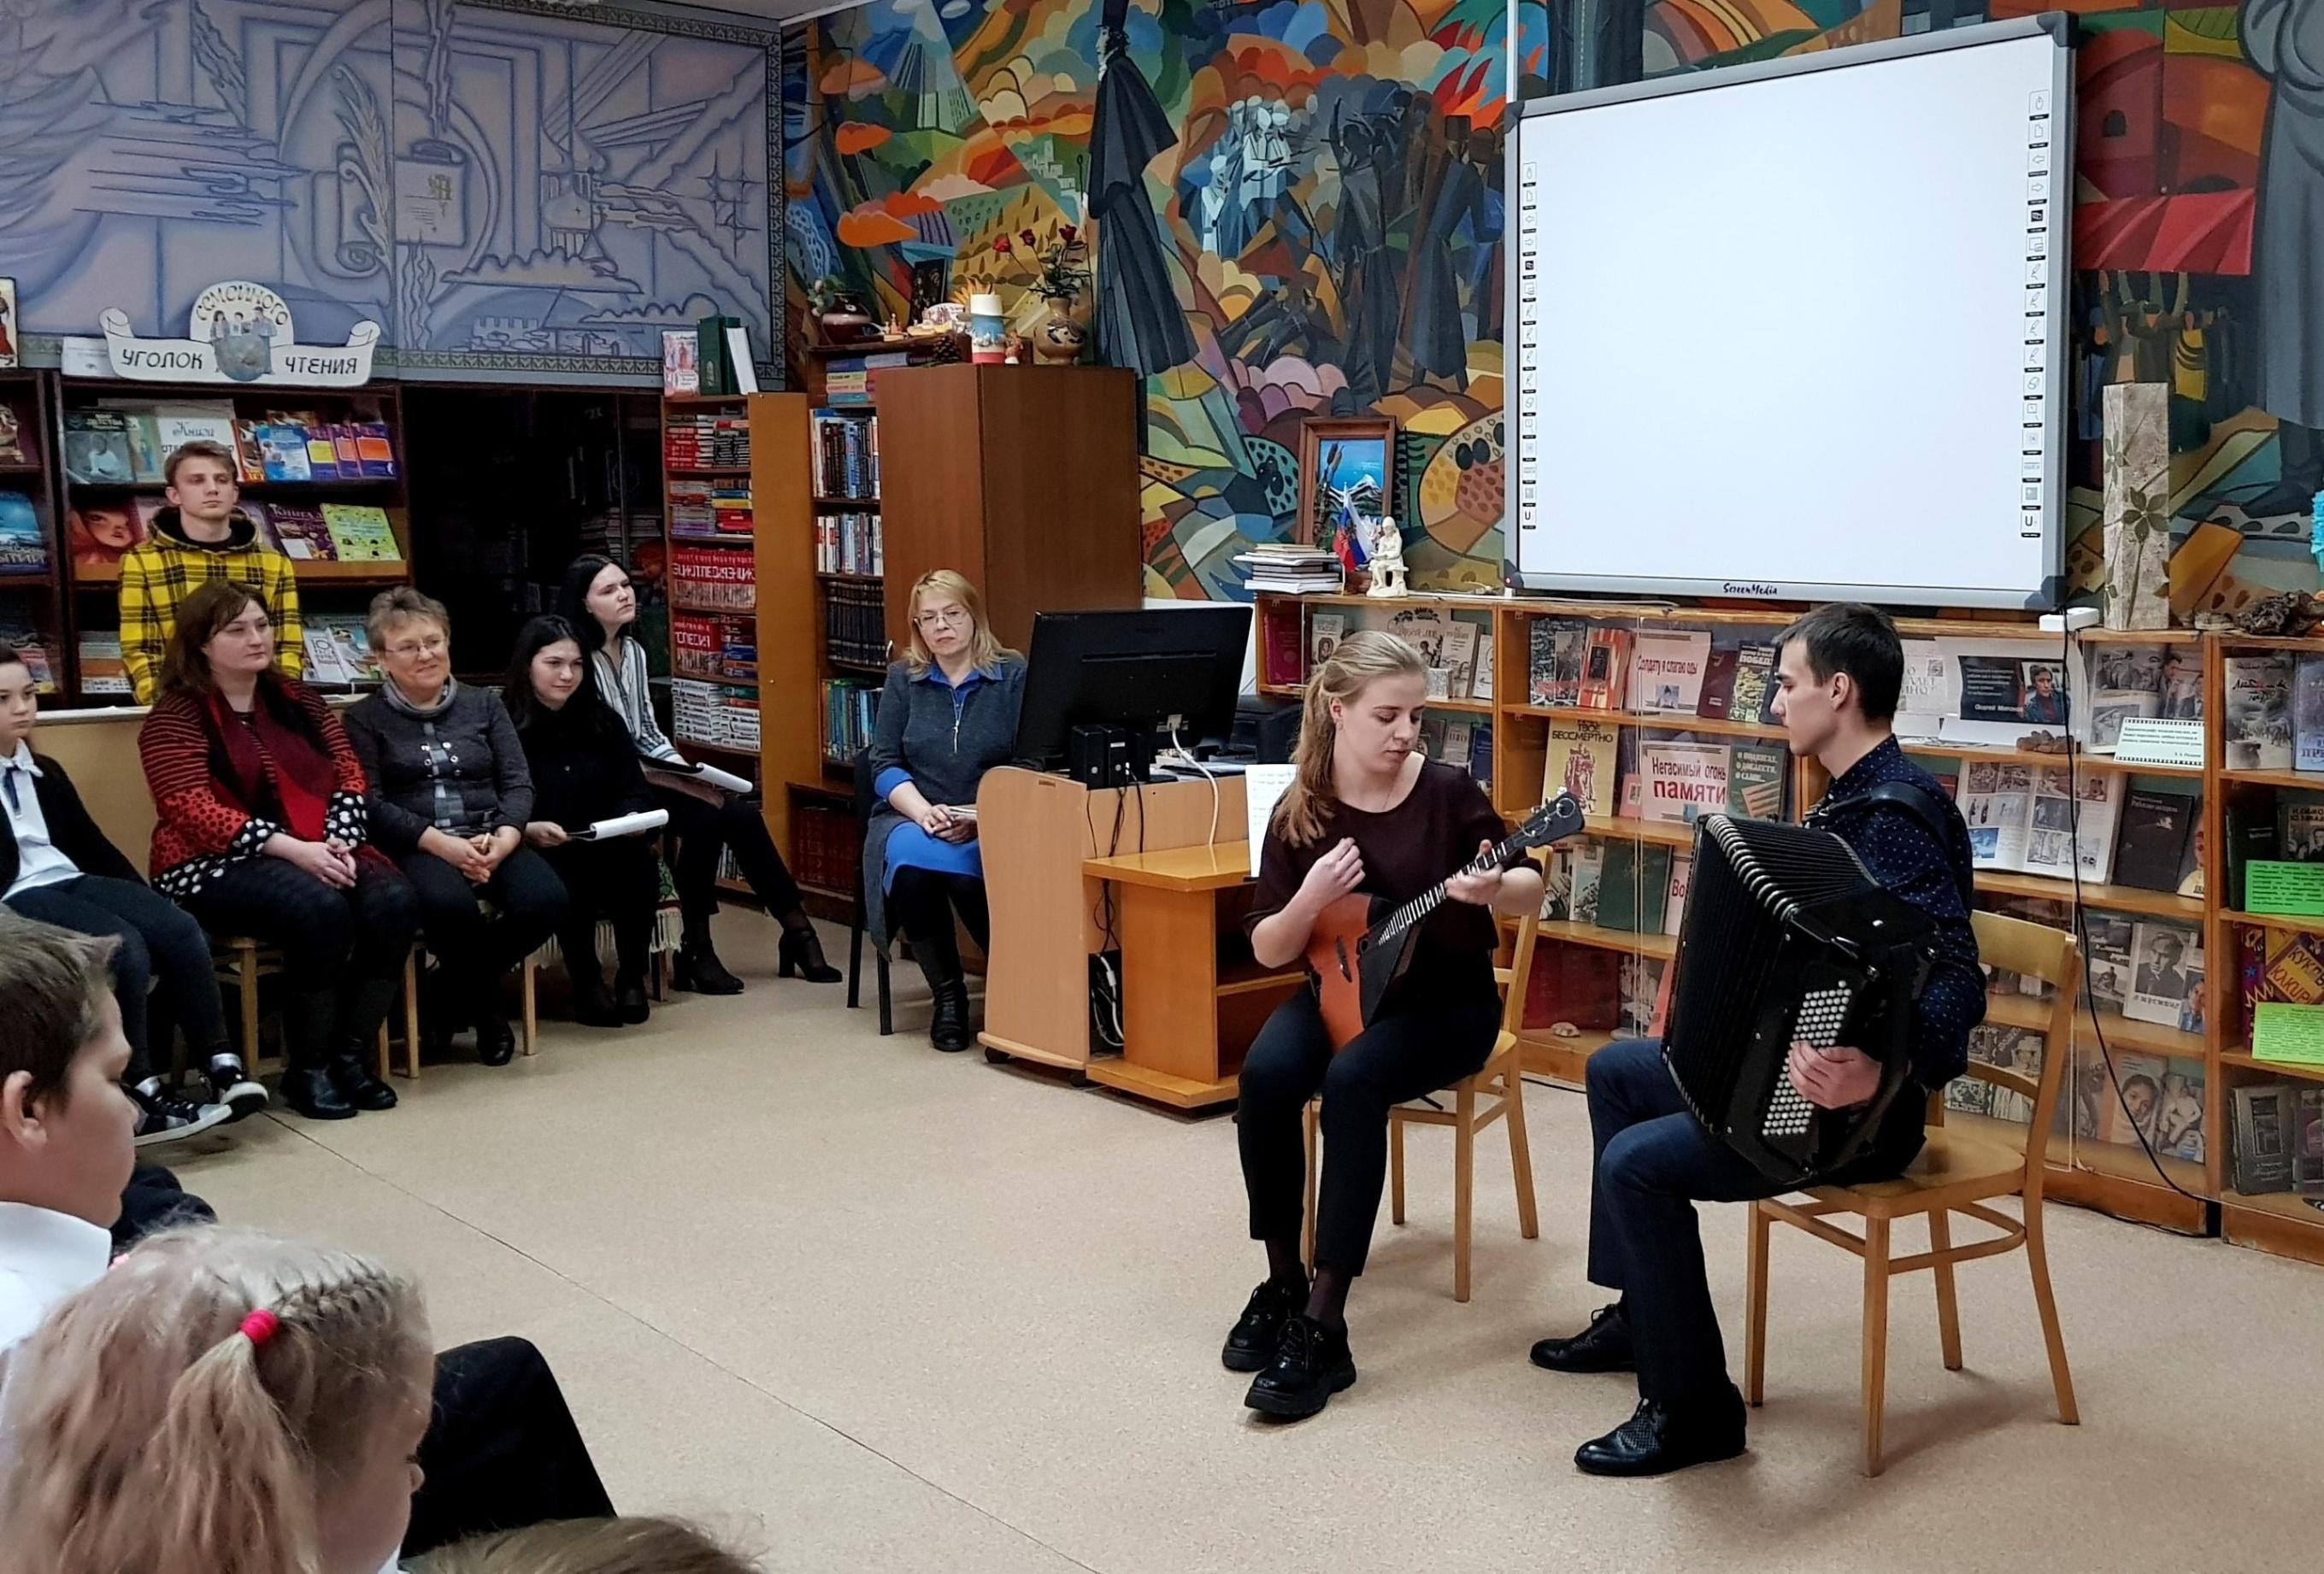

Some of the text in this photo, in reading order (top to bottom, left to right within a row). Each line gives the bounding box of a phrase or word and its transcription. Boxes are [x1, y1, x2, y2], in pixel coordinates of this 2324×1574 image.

[121, 349, 358, 375] УГОЛОК ЧТЕНИЯ
[1723, 582, 1778, 596] ScreenMedia
[1552, 731, 1614, 743] БЕССМЕРТНО
[1652, 757, 1727, 781] Негасимый огонь
